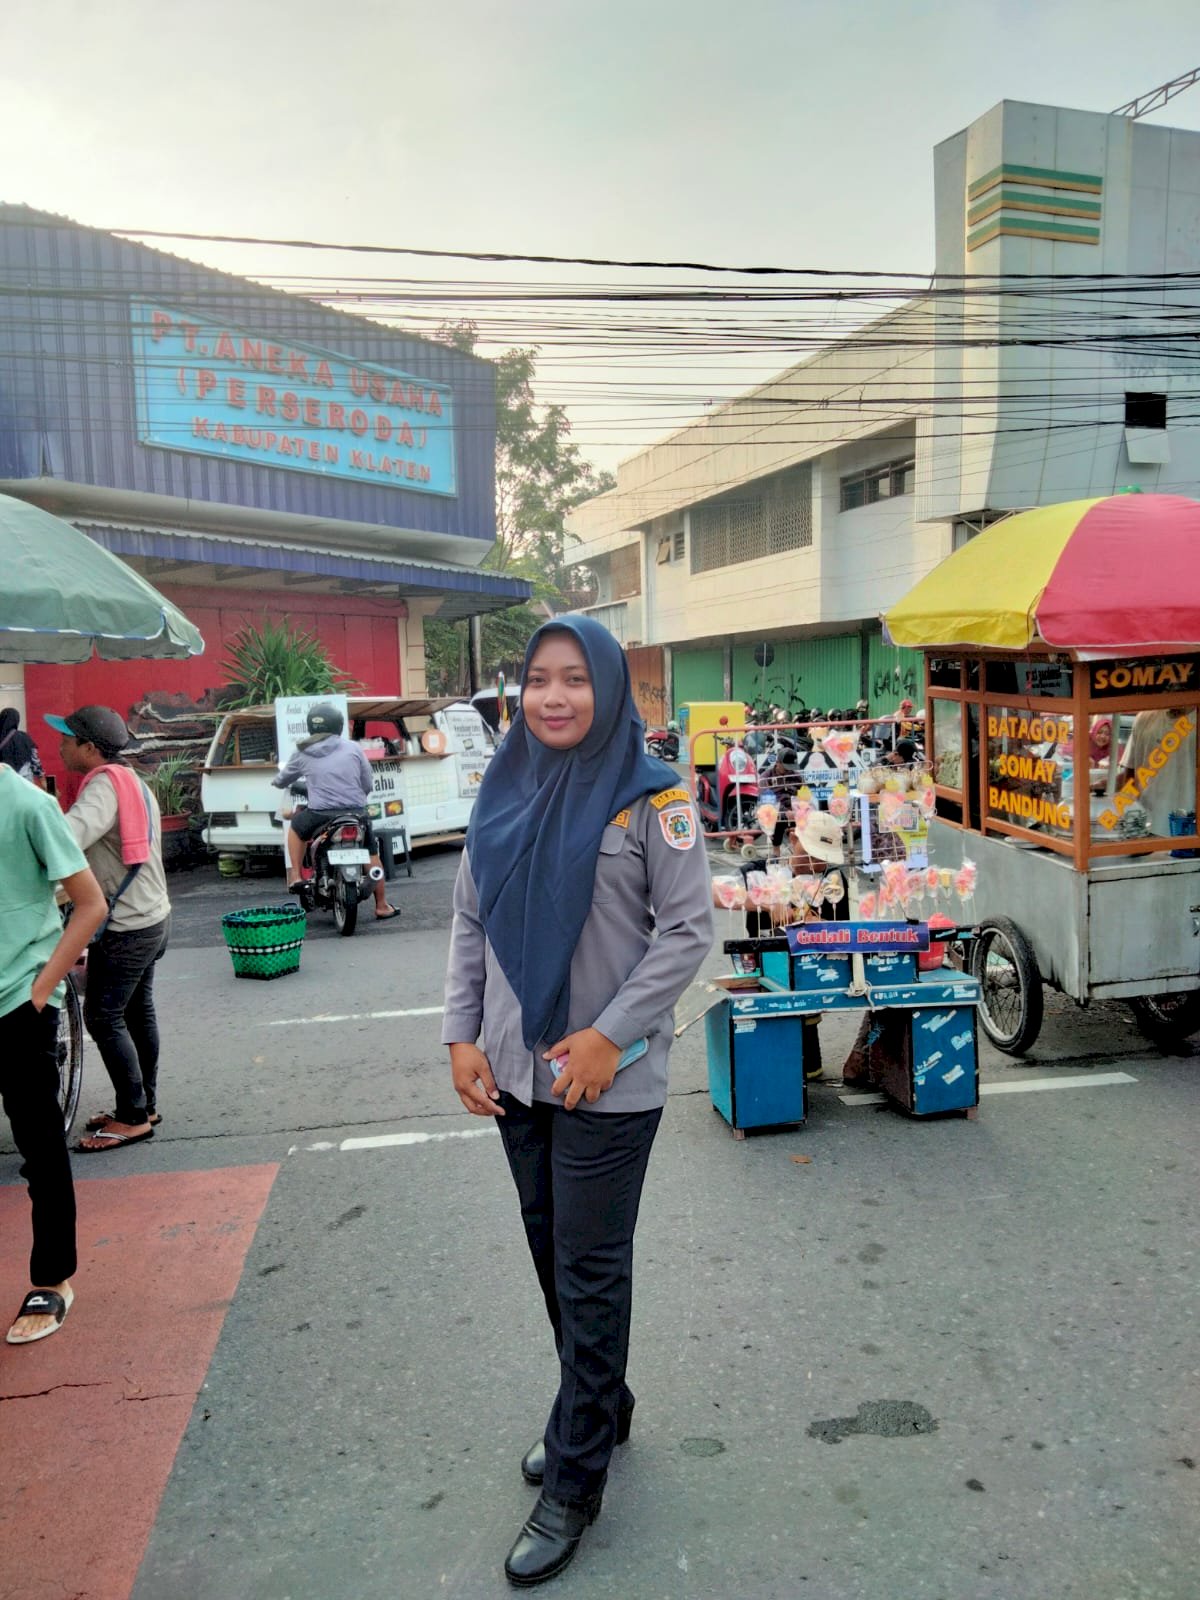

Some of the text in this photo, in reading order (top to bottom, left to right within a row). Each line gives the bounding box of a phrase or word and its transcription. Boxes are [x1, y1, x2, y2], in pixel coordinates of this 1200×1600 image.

[350, 366, 443, 417] USAHA
[177, 366, 427, 449] (PERSERODA)
[193, 416, 431, 482] KABUPATEN KLATEN
[1095, 662, 1194, 690] SOMAY
[288, 719, 307, 735] kemb
[988, 716, 1070, 745] BATAGOR
[371, 775, 395, 791] ahu
[999, 754, 1056, 784] SOMAY
[1099, 714, 1195, 831] BATAGOR
[989, 786, 1070, 829] BANDUNG
[796, 927, 919, 944] Gulali Bentuk
